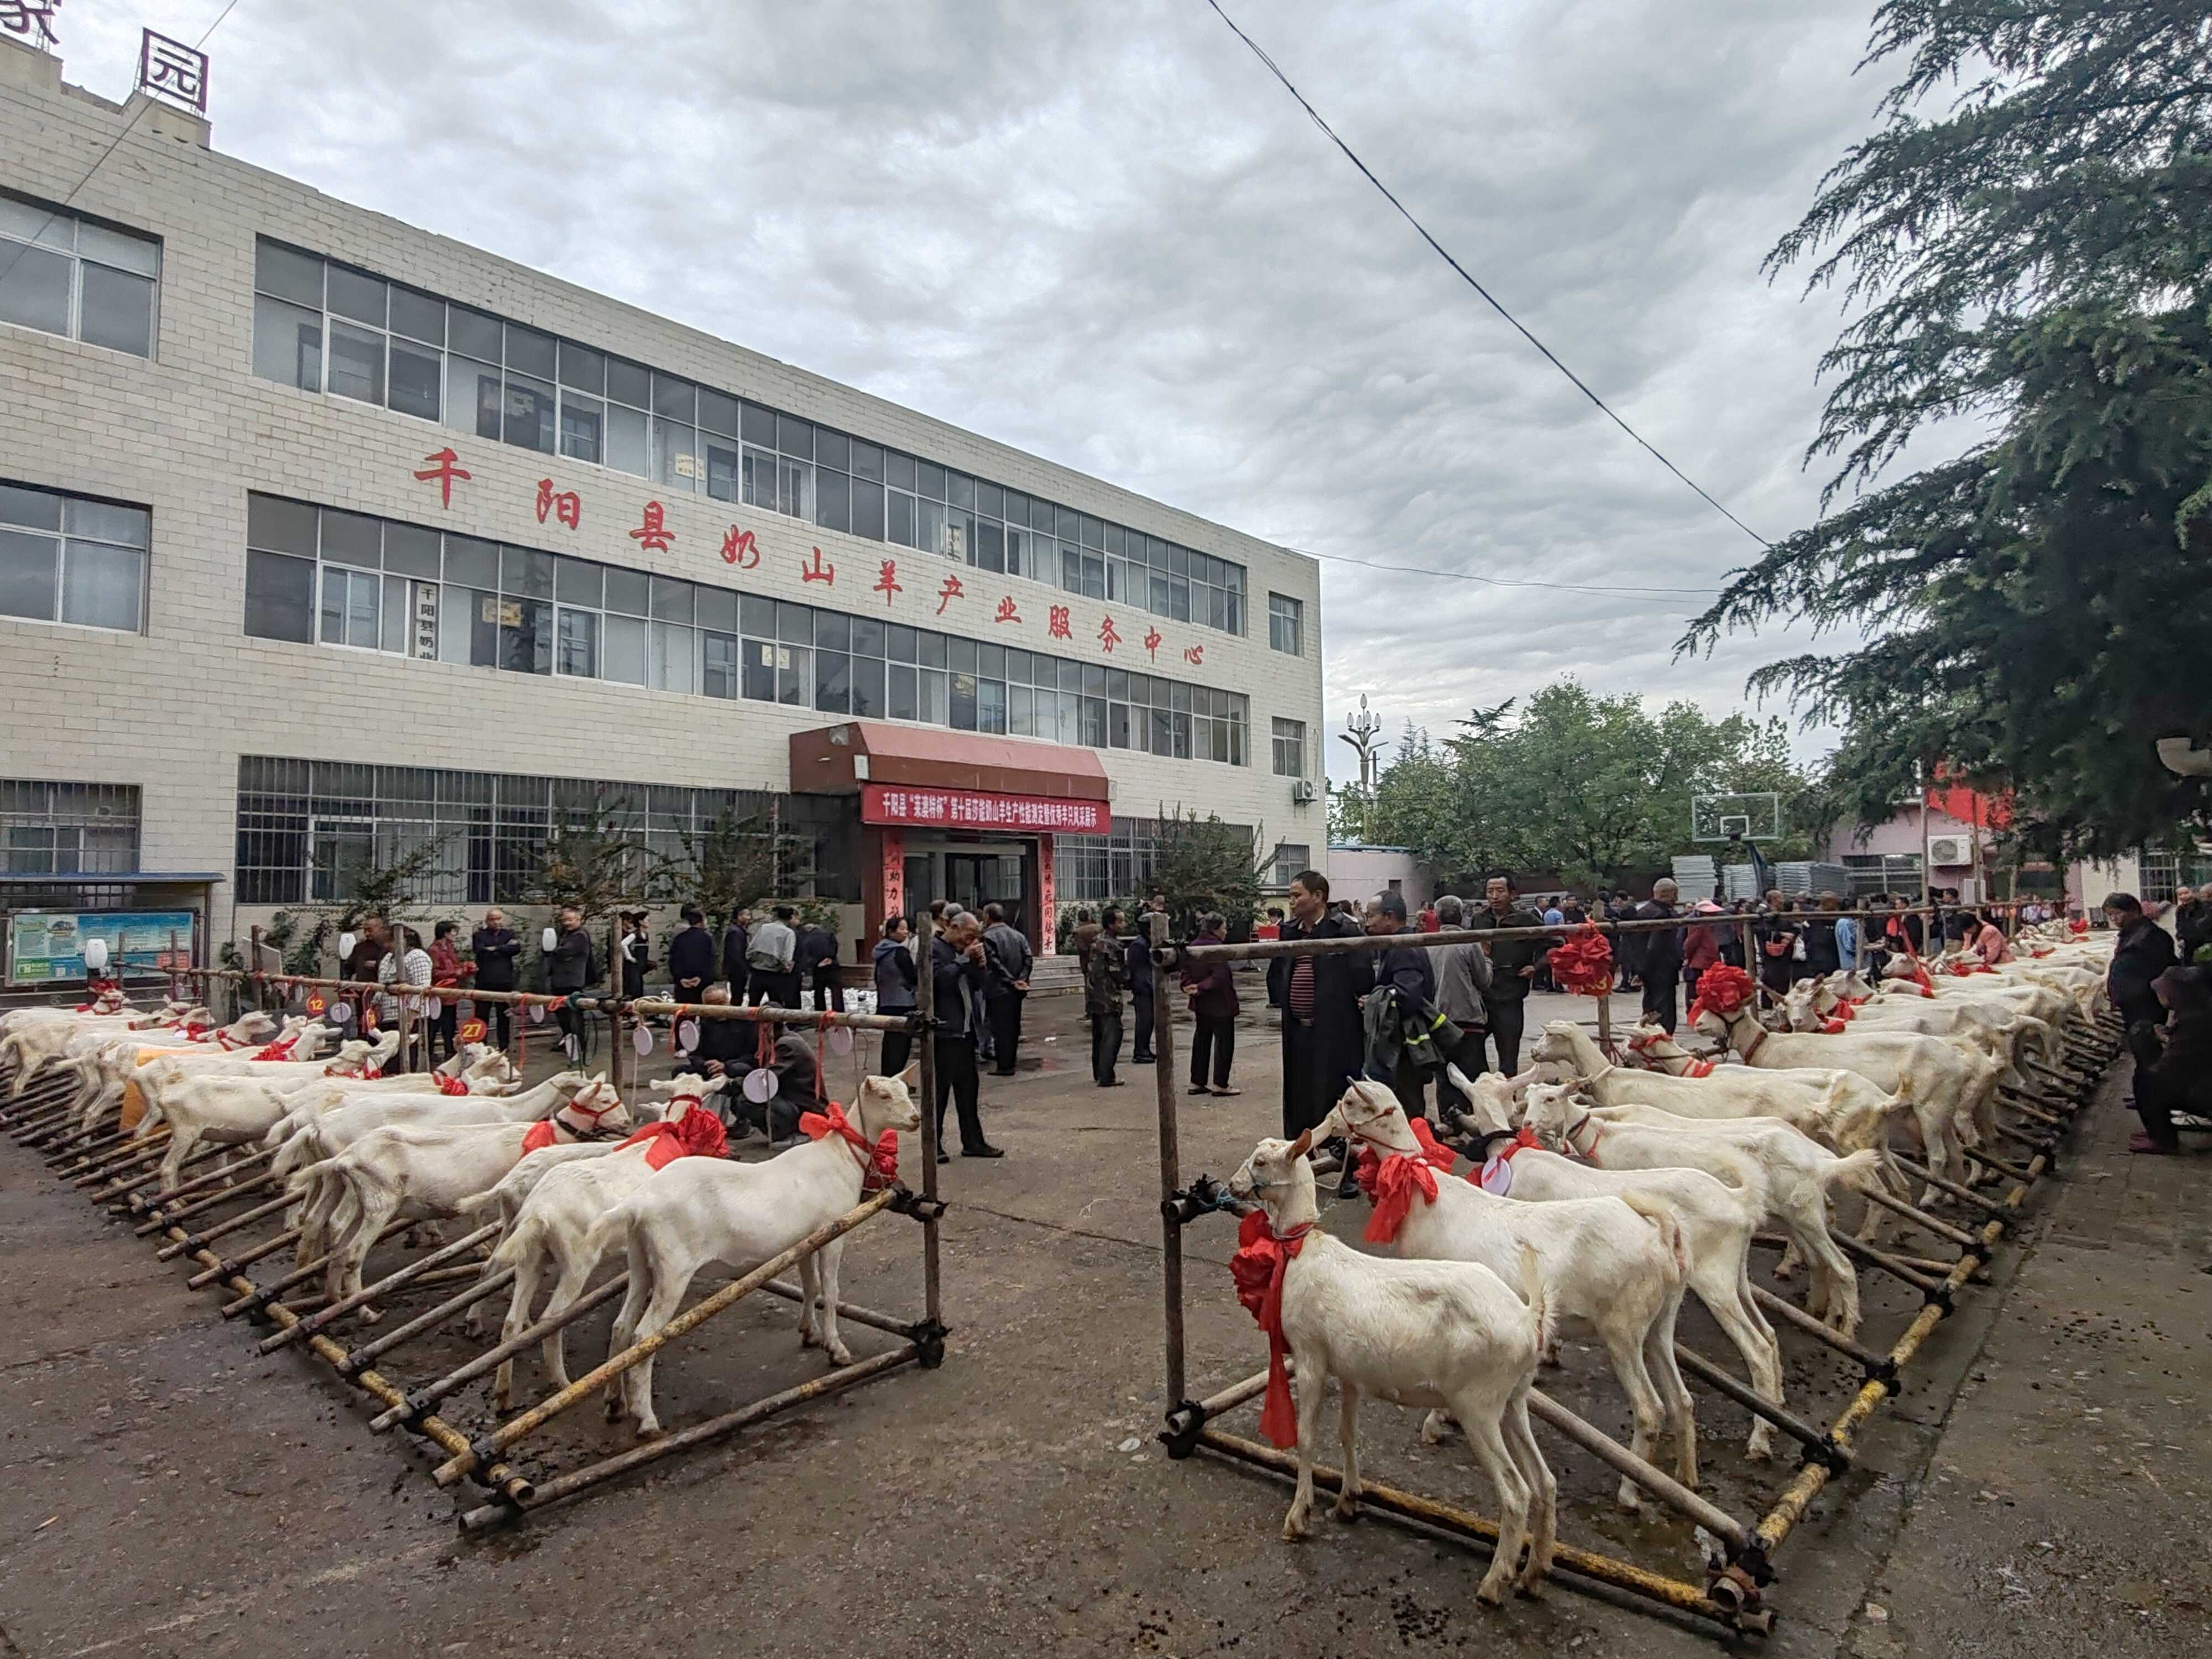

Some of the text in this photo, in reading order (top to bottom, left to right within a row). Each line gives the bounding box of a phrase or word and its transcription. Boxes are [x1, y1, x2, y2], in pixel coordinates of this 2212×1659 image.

[414, 447, 1204, 665] 千阳县奶山羊产业服务中心
[310, 999, 323, 1011] 12
[463, 1024, 482, 1037] 27
